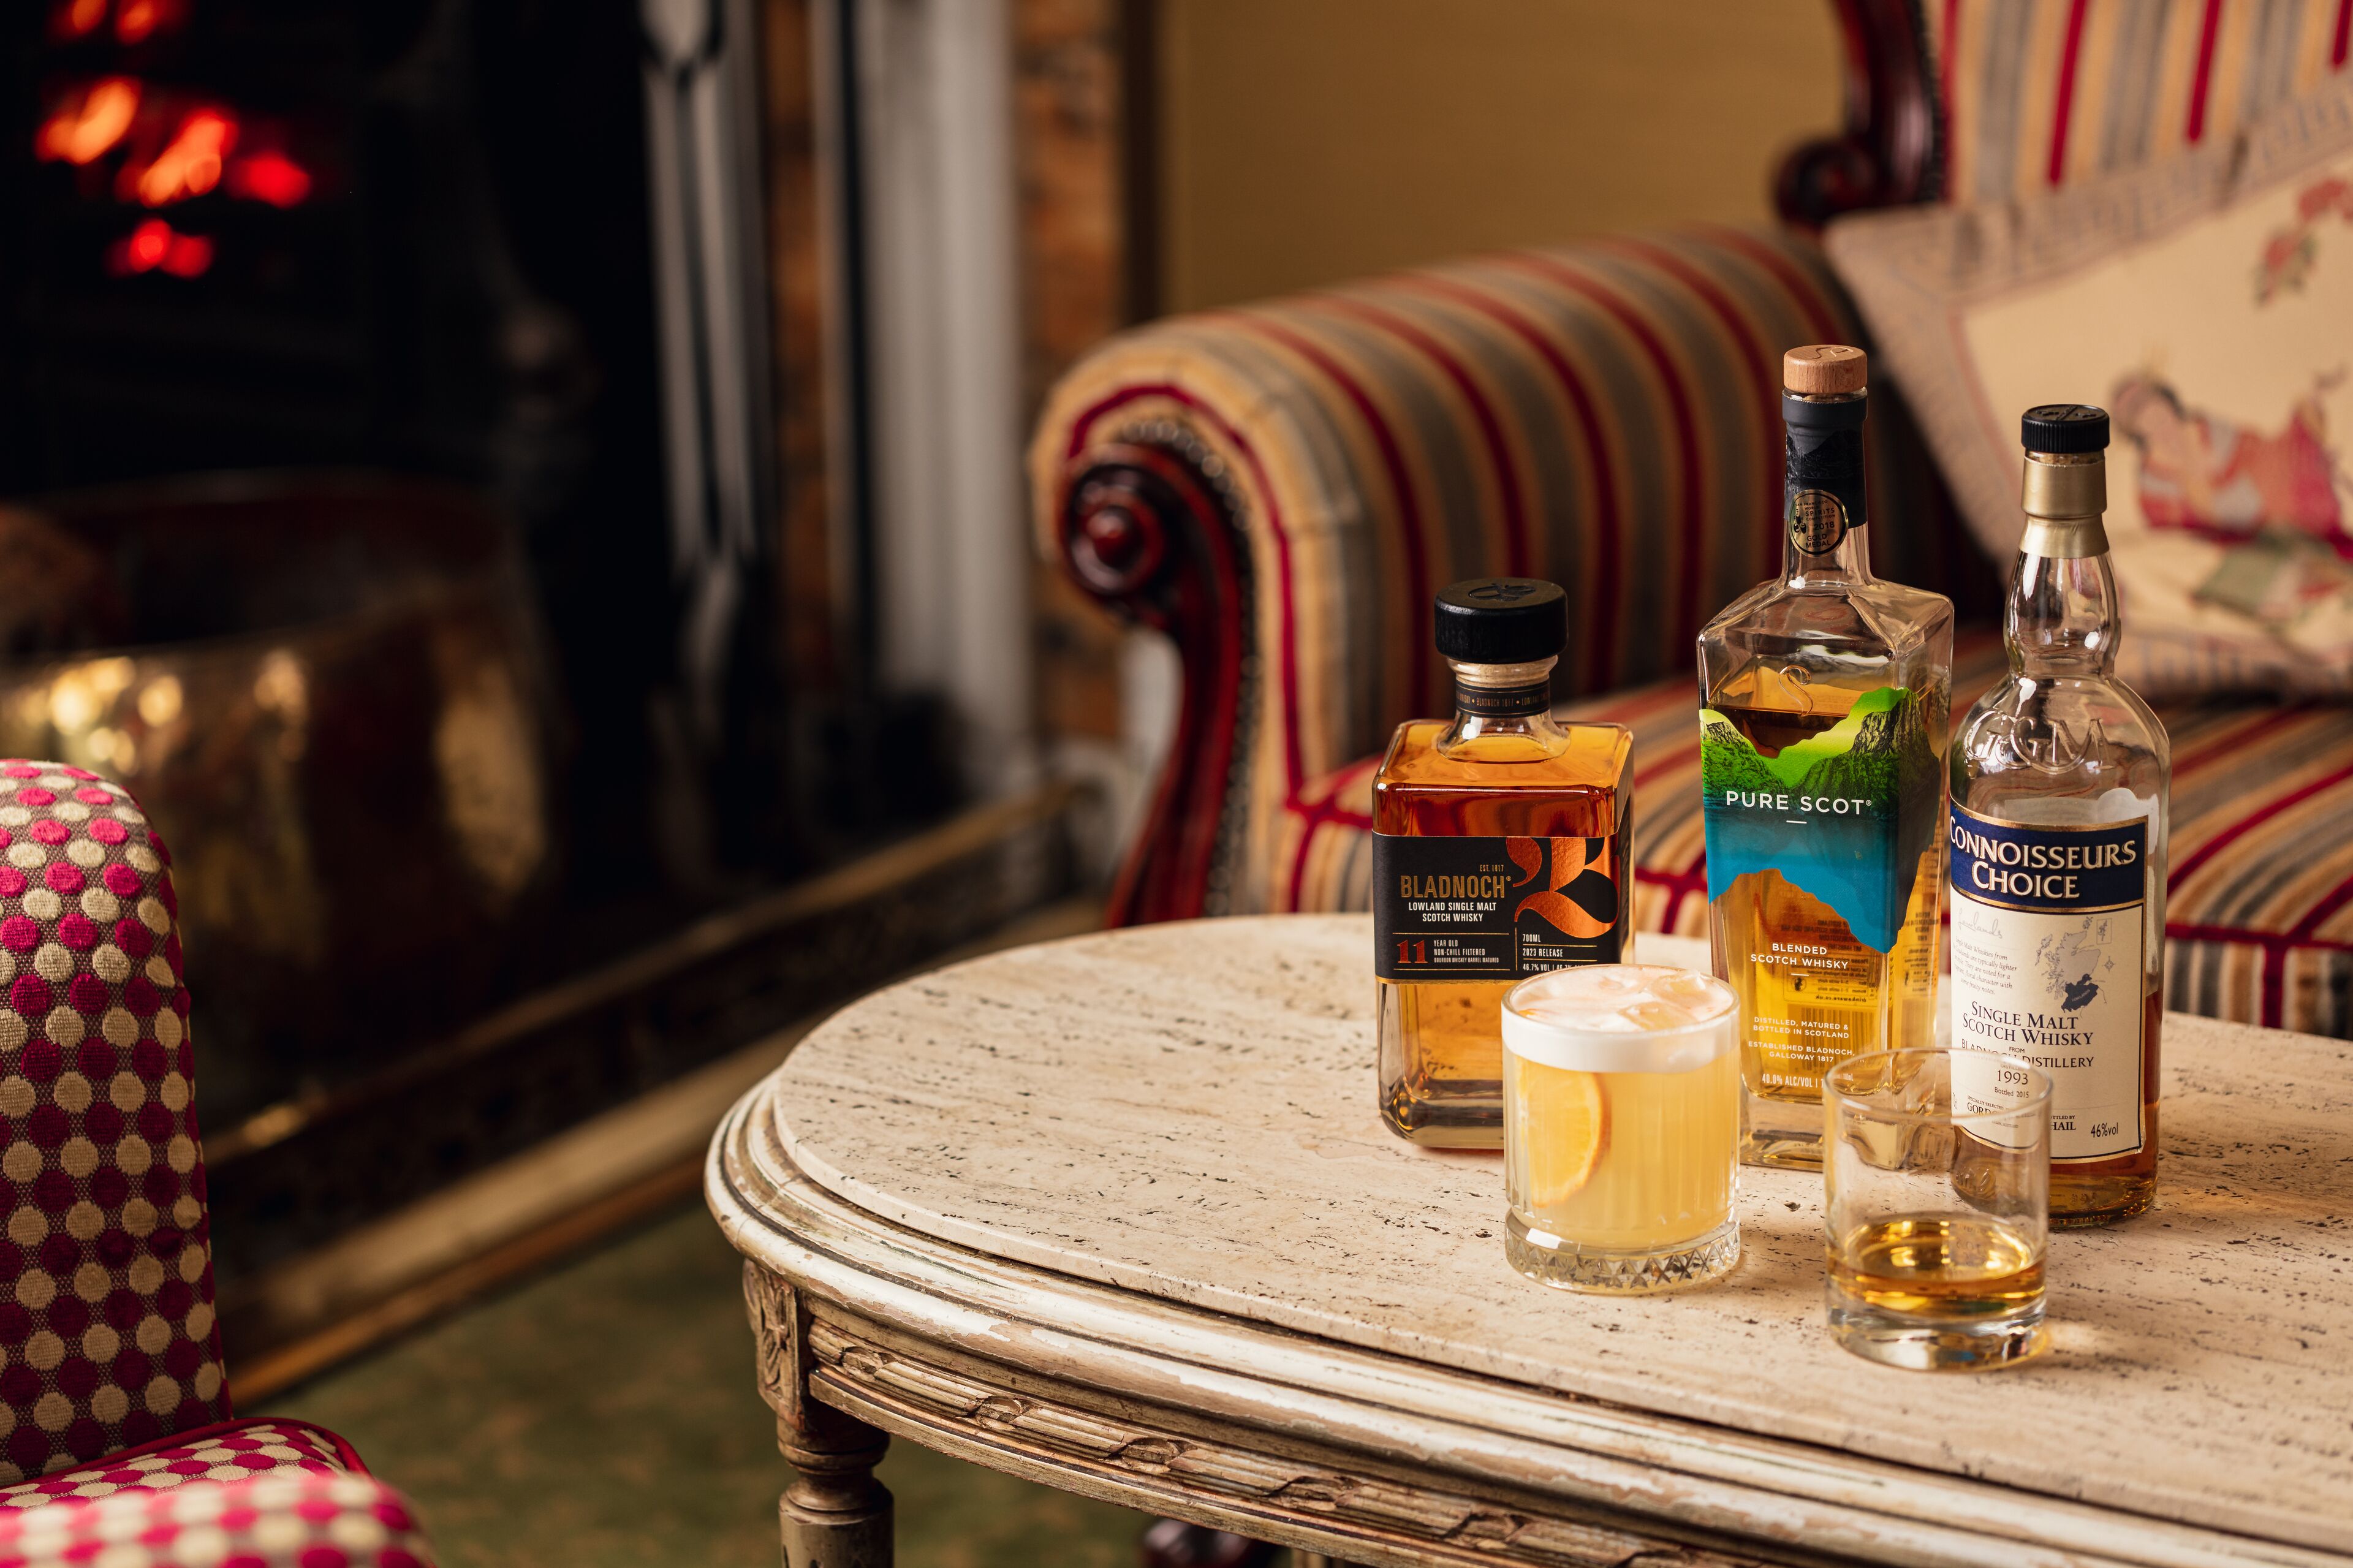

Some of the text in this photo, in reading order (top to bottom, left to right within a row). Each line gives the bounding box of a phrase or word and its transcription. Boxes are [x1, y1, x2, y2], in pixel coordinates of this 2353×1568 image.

[1805, 507, 1835, 517] SPIRITS
[1814, 521, 1835, 531] 2018
[1806, 540, 1831, 548] MEDAL
[1476, 697, 1500, 706] BLADNOCH
[1502, 699, 1514, 707] 1817
[1726, 790, 1789, 810] PURE
[1950, 816, 2137, 869] CONNOISSEURS
[1972, 860, 2080, 899] CHOICE
[1409, 902, 1497, 911] LOWLAND SINGLE MALT
[1422, 913, 1483, 922] SCOTCH WHISKY
[1522, 934, 1541, 942] 700ML
[1396, 940, 1428, 963] 11
[1523, 948, 1563, 957] 2023 RELEASE
[1771, 943, 1827, 955] BLENDED
[1974, 945, 1993, 958] Whiskies
[1994, 952, 2007, 960] from
[1751, 953, 1797, 965] SCOTCH
[1802, 958, 1849, 969] WHISKY
[1978, 956, 1998, 968] typically
[1999, 962, 2018, 971] lighter
[1976, 975, 1999, 986] character
[1981, 987, 1996, 995] notes.
[2072, 989, 2091, 1002] LOWLANDS
[1972, 1001, 2078, 1029] SINGLE MALT
[1754, 1017, 1798, 1027] DISTILLED,
[1801, 1021, 1840, 1030] MATURED
[1963, 1013, 2094, 1045] SCOTCH WHISKY
[1752, 1025, 1790, 1034] BOTTLED
[1805, 1030, 1849, 1039] SCOTLAND
[1748, 1041, 1855, 1057] ESTABLISHED BLADNOCH,
[1769, 1051, 1815, 1061] GALLOWAY
[2021, 1056, 2094, 1069] DISTILLERY
[1762, 1073, 1783, 1085] 40.0%
[1785, 1075, 1813, 1088] ALC/VOL
[1998, 1069, 2028, 1085] 1993
[1995, 1086, 2014, 1096] Bottled
[1967, 1095, 1985, 1105] SPECIALLY
[1967, 1102, 1998, 1115] GORD
